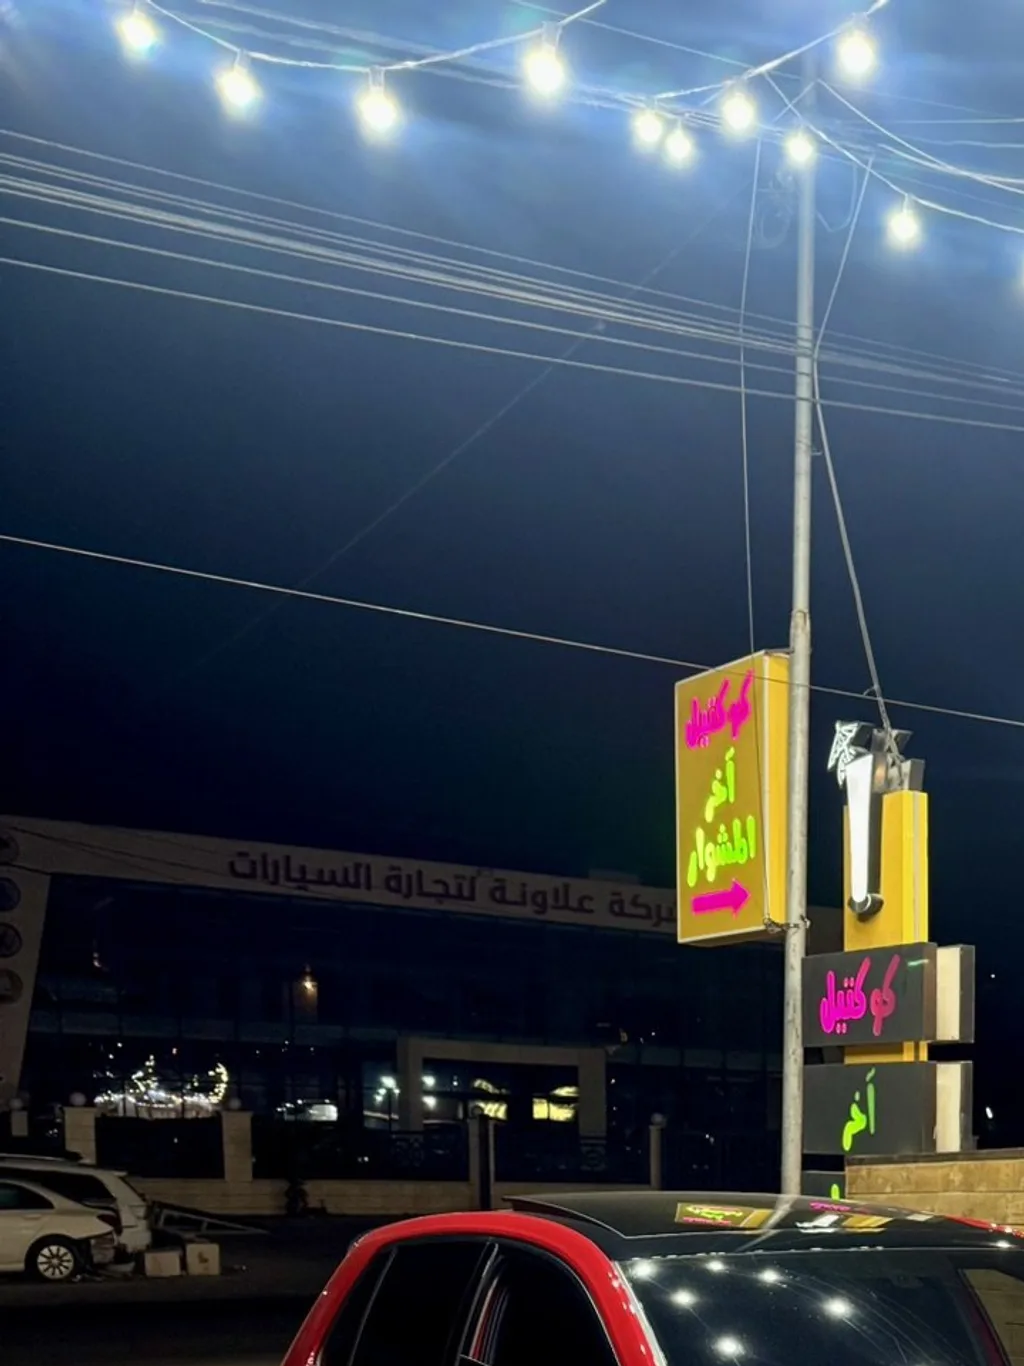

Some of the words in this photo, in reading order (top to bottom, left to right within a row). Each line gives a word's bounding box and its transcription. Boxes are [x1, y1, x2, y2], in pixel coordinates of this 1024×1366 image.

[228, 850, 372, 892] السيارات
[686, 814, 757, 888] المشوار
[384, 863, 477, 905] لتجارة
